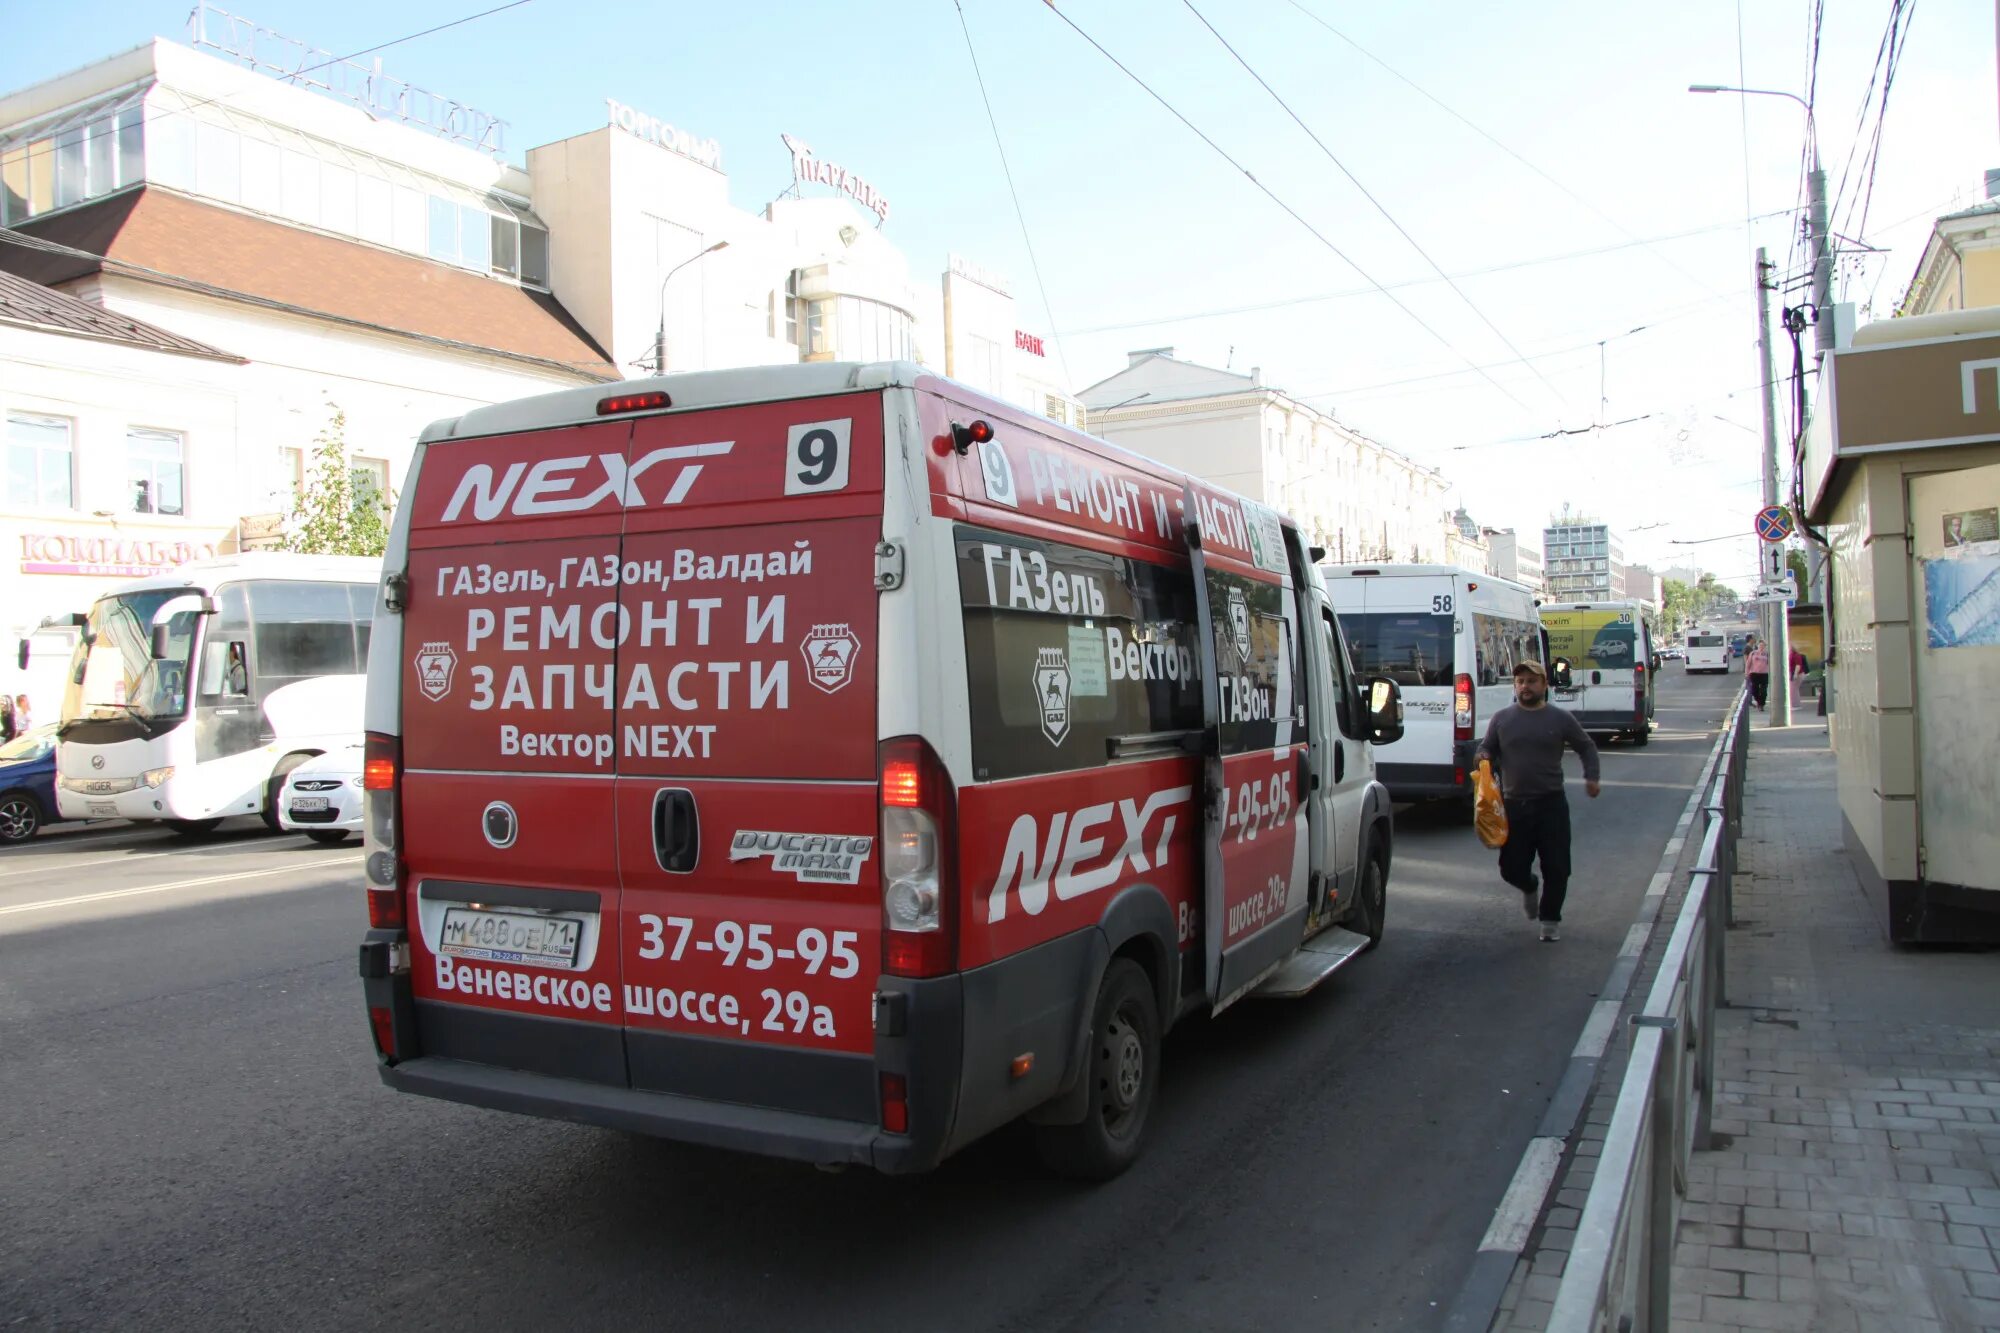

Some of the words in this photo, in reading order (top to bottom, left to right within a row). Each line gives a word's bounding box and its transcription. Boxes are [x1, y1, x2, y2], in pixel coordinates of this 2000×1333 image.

[606, 97, 721, 169] ТОРГОВЫЙ
[800, 156, 888, 220] ПАРАДИЗ
[1014, 329, 1046, 357] БАНК
[440, 440, 736, 522] NEXT
[797, 428, 838, 485] 9
[985, 443, 1008, 496] 9
[1027, 448, 1144, 532] РЕМОНТ
[1150, 489, 1173, 540] И
[20, 534, 216, 566] КОМИЛЬФО
[1248, 522, 1263, 566] 9
[982, 543, 1105, 617] ГАЗель
[1432, 595, 1452, 612] 58
[467, 598, 722, 652] РЕМОНТ
[745, 595, 786, 644] И
[1619, 613, 1630, 623] 30
[1107, 627, 1192, 690] Вектор
[470, 660, 789, 711] ЗАПЧАСТИ
[1218, 676, 1270, 724] ГАЗон
[1047, 713, 1064, 723] GAZ
[501, 725, 614, 765] Вектор
[624, 725, 717, 758] NEXT
[86, 781, 112, 791] HIGER
[733, 831, 871, 854] DUCATO
[778, 854, 853, 870] MAXI
[988, 784, 1191, 924] NEXT
[543, 944, 559, 952] RUS
[639, 913, 859, 979] 37-95-95
[435, 955, 611, 1012] Веневское
[625, 984, 750, 1035] шоссе,
[761, 988, 836, 1038] 29а
